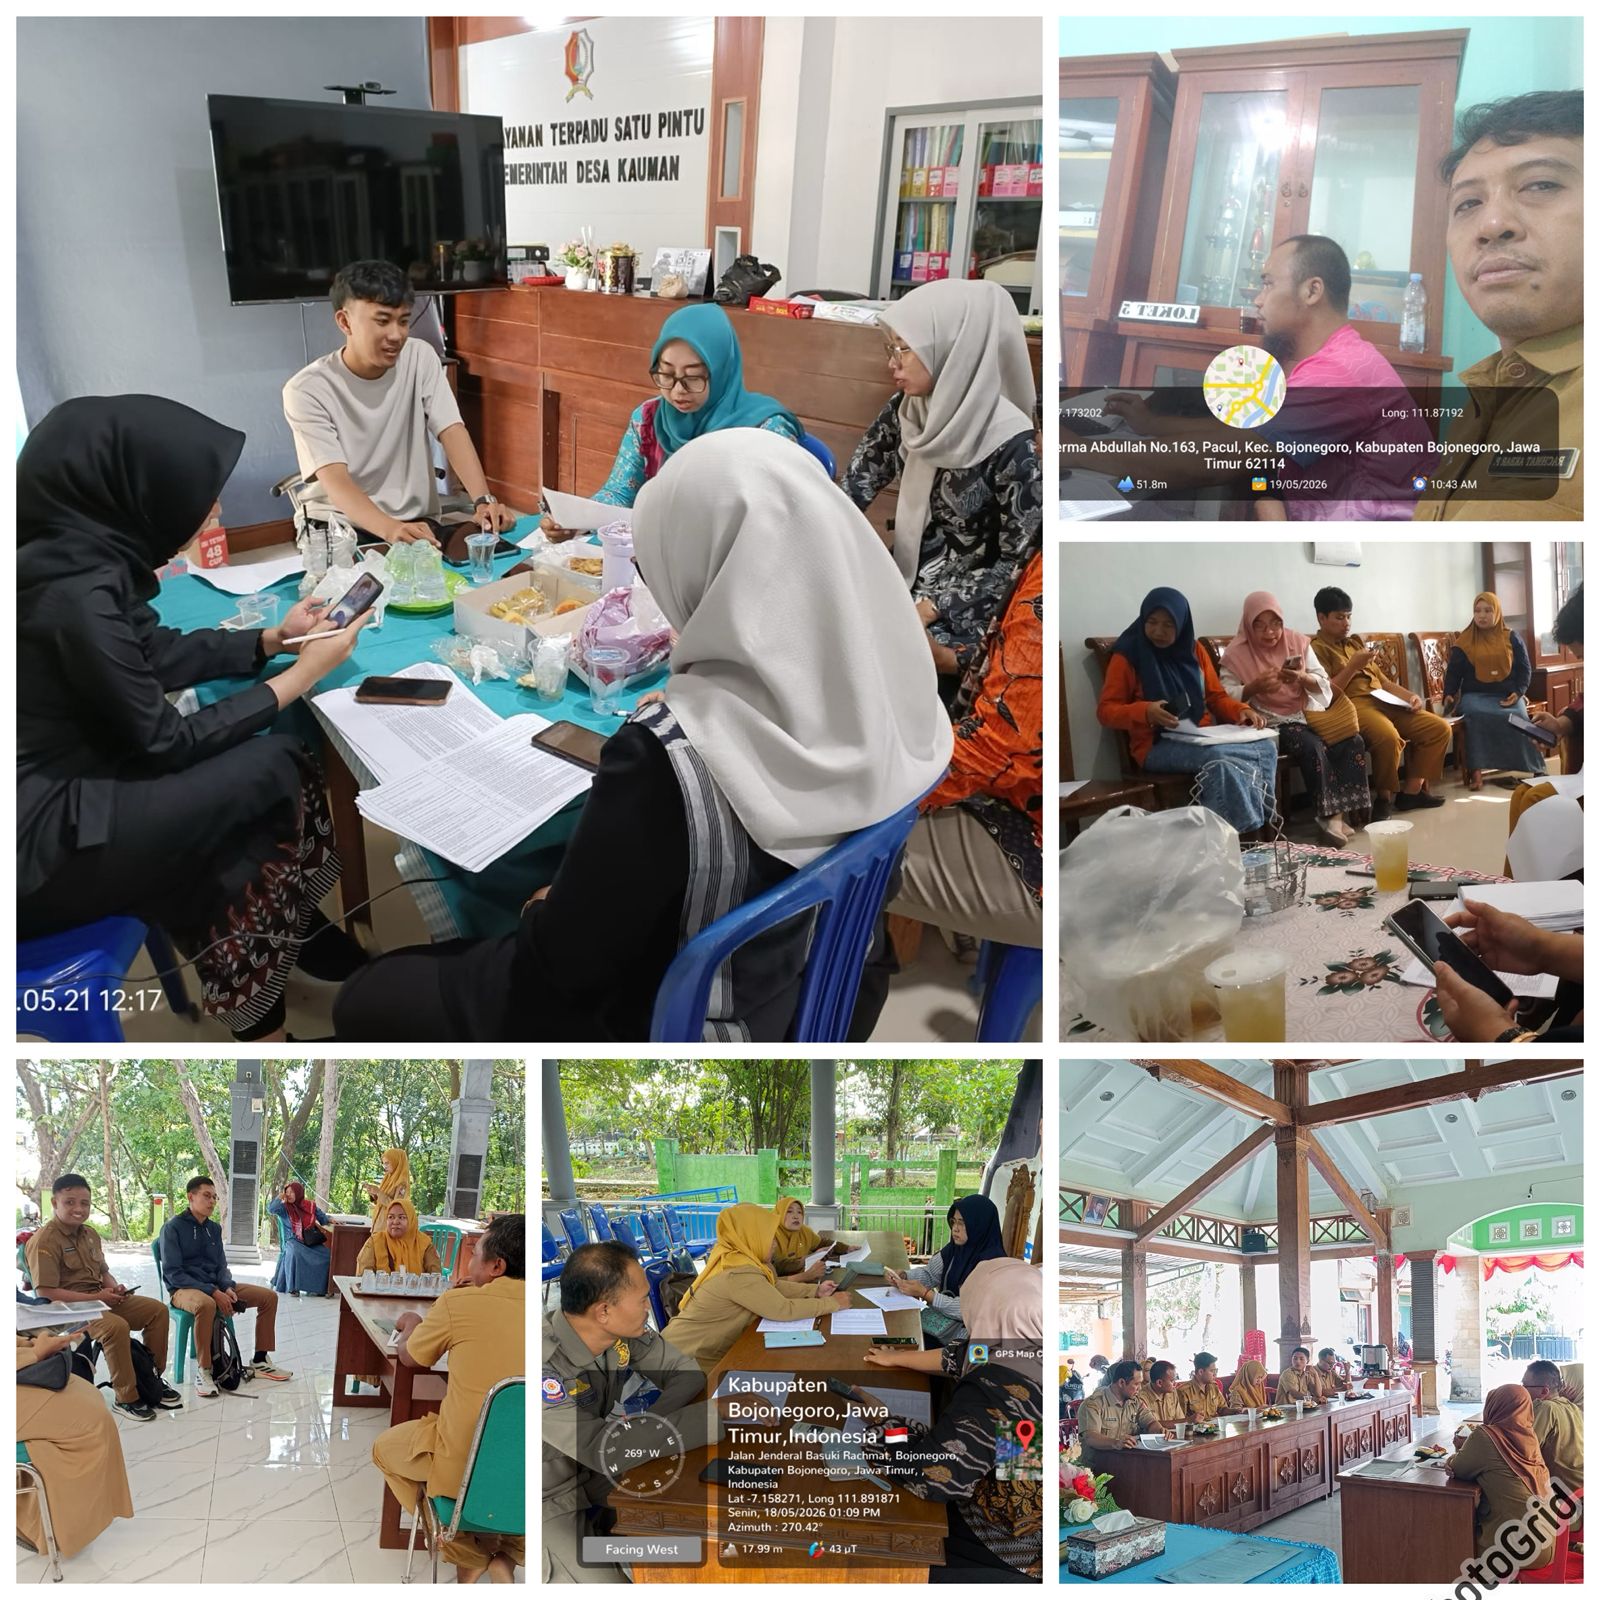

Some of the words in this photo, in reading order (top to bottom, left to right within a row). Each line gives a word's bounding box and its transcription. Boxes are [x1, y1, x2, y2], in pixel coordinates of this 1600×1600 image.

[550, 118, 608, 146] TERPADU
[614, 114, 651, 142] SATU
[658, 108, 705, 139] PINTU
[576, 159, 610, 183] DESA
[617, 155, 680, 183] KAUMAN
[207, 544, 222, 558] 48
